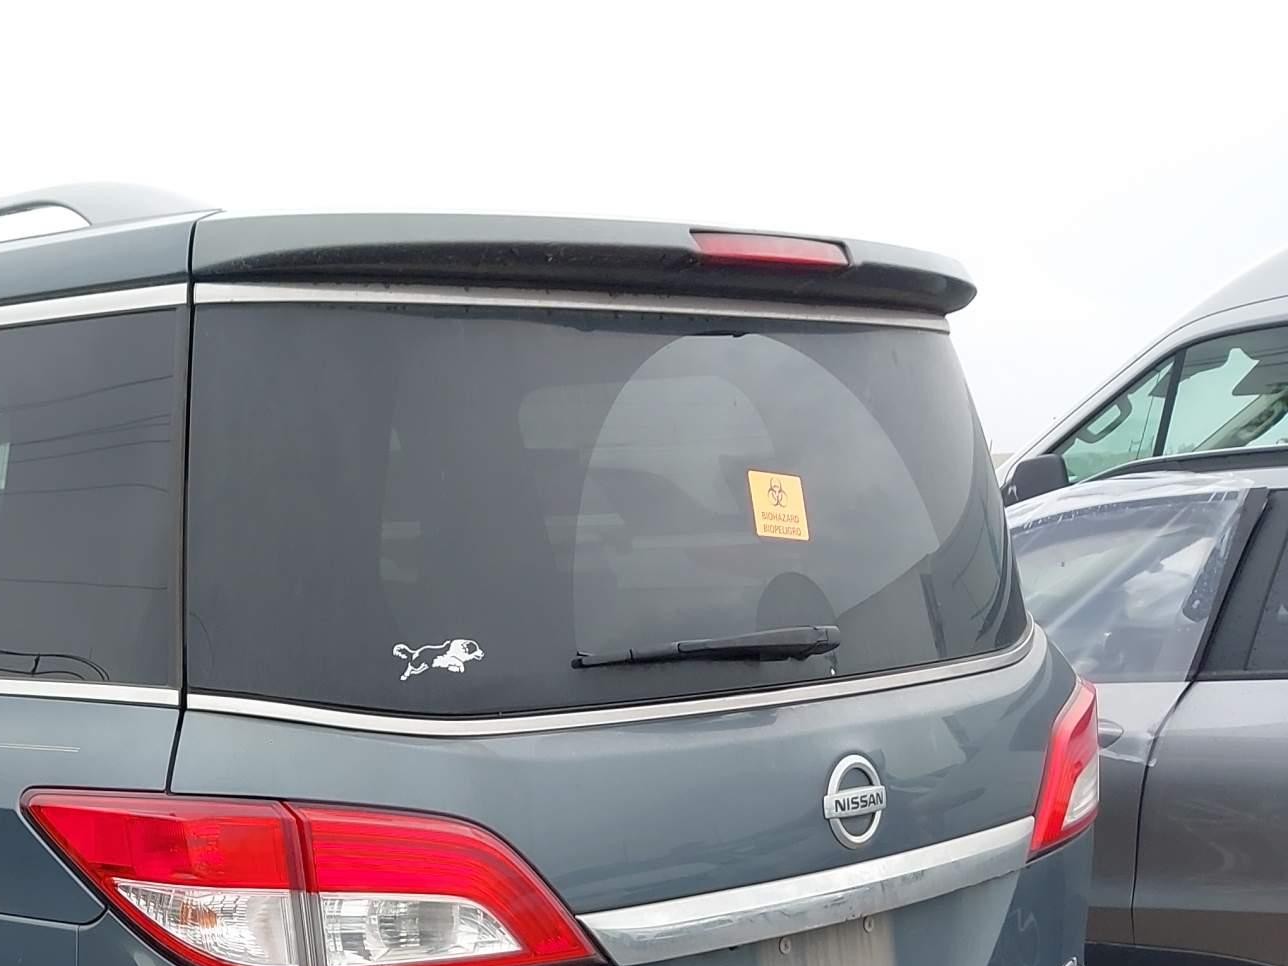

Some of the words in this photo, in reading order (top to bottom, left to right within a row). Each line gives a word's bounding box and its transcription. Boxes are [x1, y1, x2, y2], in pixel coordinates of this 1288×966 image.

[761, 511, 800, 524] BIOHAZARD
[763, 523, 802, 537] BIOPELIGRO
[834, 791, 883, 813] NISSAN
